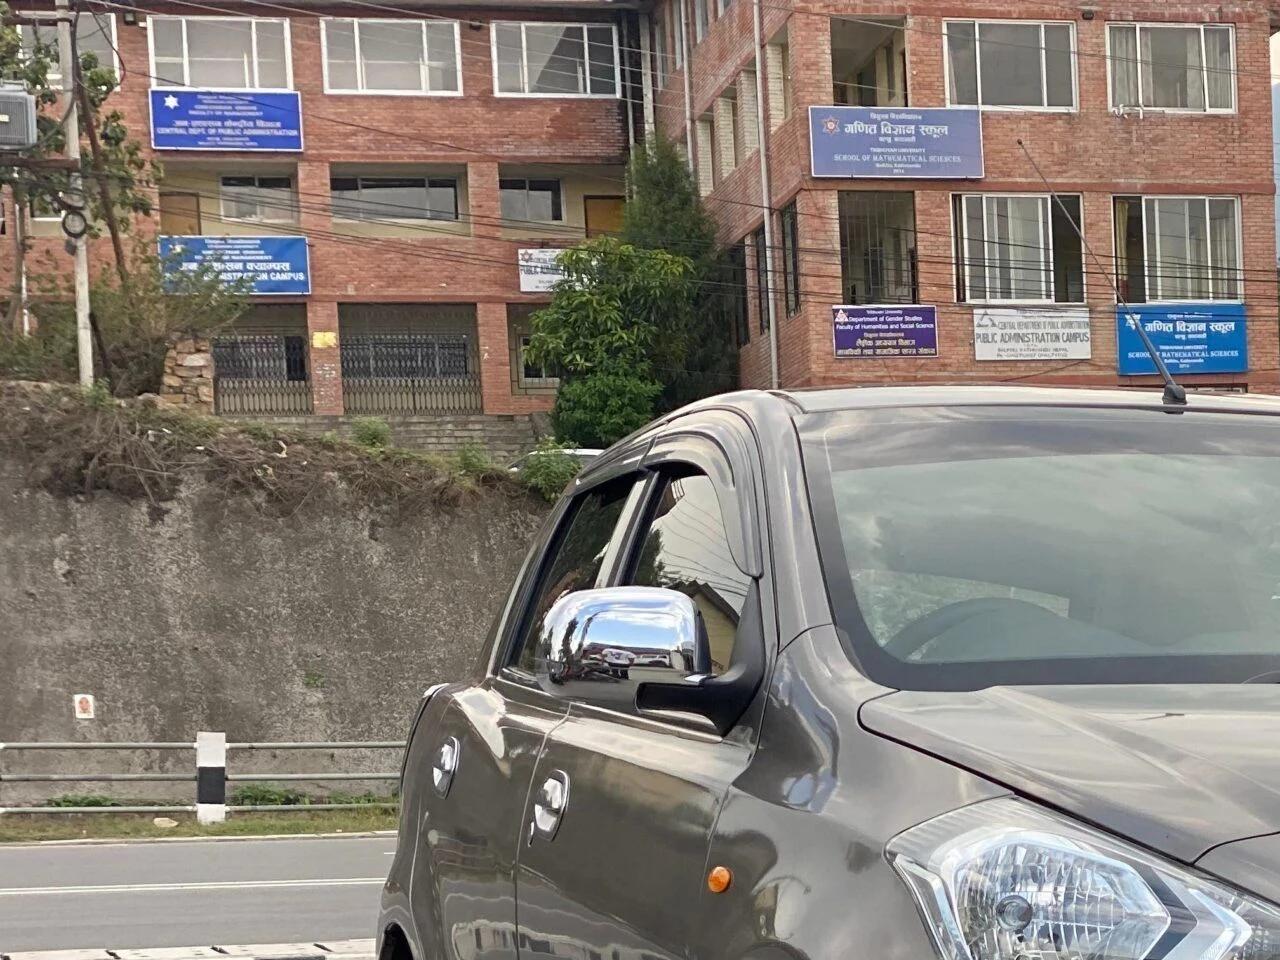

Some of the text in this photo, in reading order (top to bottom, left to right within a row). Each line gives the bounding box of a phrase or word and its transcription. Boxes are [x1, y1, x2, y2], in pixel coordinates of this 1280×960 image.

[844, 121, 948, 138] गणित विज्ञान स्कूल
[873, 154, 928, 162] MATHEMATICAL
[269, 272, 305, 280] CAMPUS
[1144, 321, 1235, 334] गणित विज्ञान स्कूल
[976, 332, 1089, 343] PUBLIC ADMINISTRATION CAMPUS
